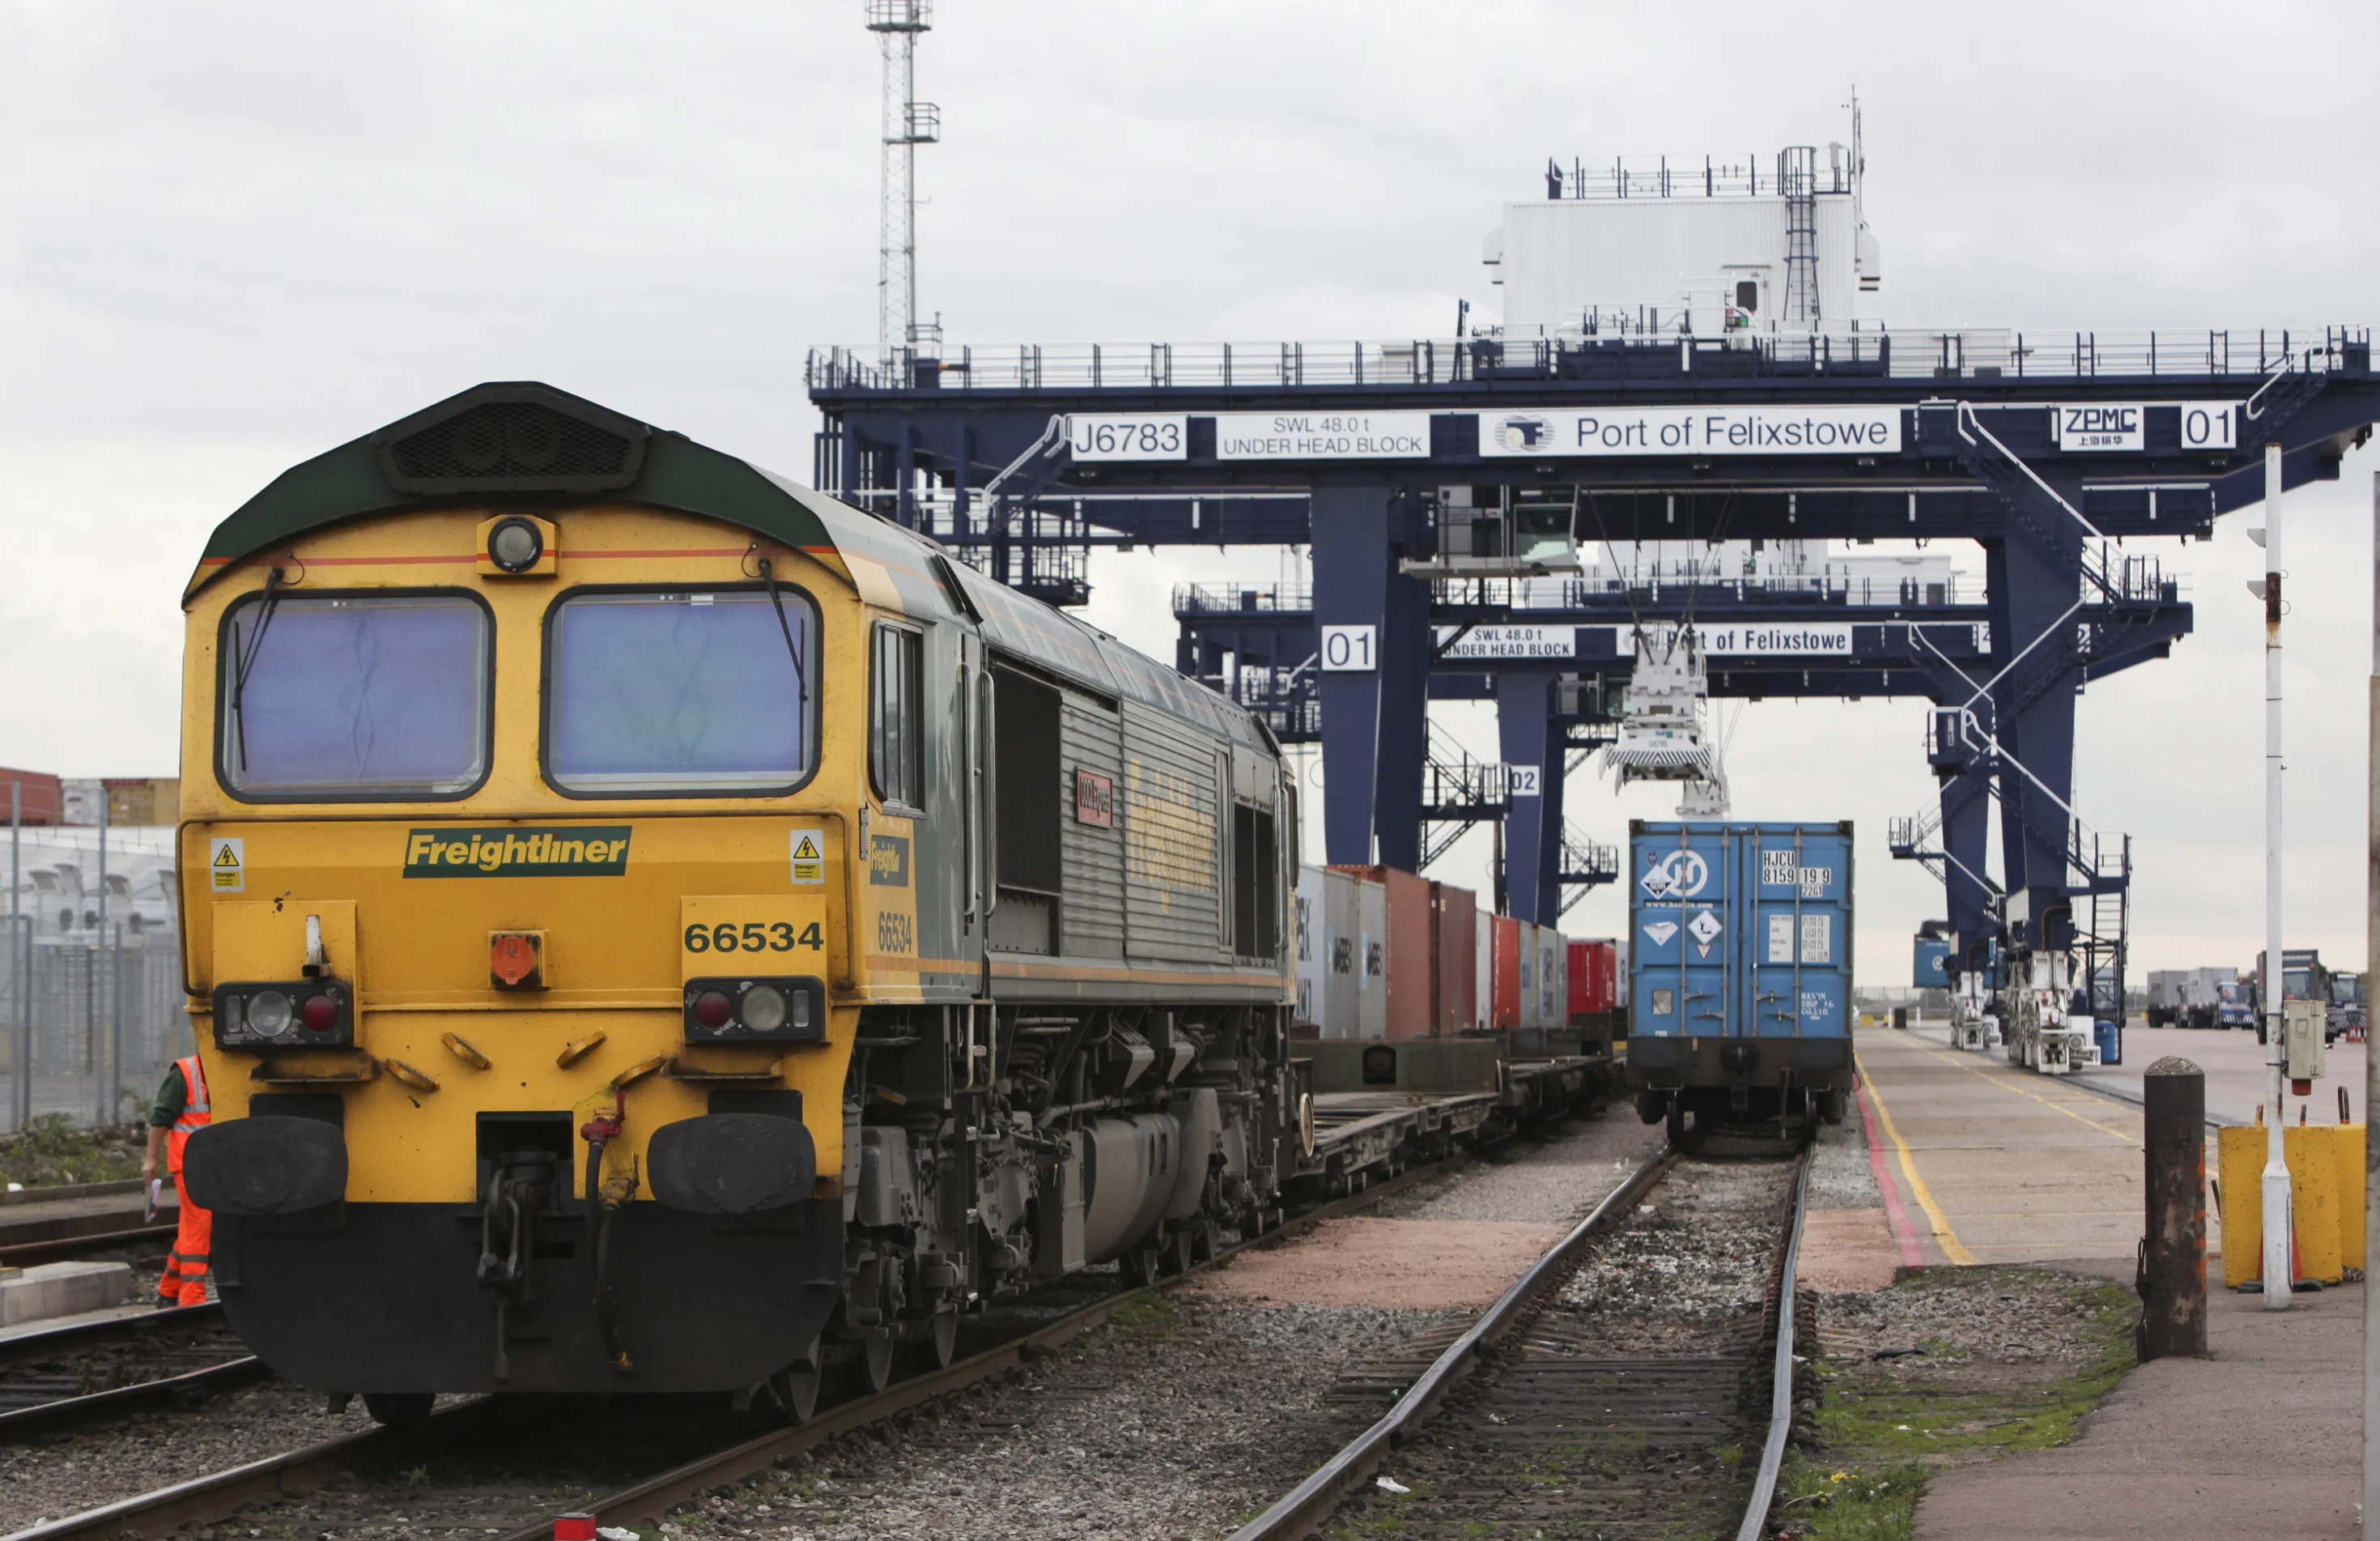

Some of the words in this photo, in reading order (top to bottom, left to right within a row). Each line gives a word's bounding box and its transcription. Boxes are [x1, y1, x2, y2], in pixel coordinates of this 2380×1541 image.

[1273, 417, 1315, 434] SWL
[1320, 417, 1358, 433] 48.0
[1363, 418, 1370, 432] t
[2065, 408, 2137, 433] ZPMC
[2186, 409, 2229, 445] 01
[1075, 423, 1180, 453] J6783
[1578, 417, 1647, 448] Port
[1660, 416, 1693, 447] of
[1706, 416, 1888, 446] Felixstowe
[1224, 438, 1291, 455] UNDER
[1298, 437, 1350, 453] HEAD
[1357, 436, 1422, 453] BLOCK
[1474, 629, 1501, 641] SWL
[1505, 628, 1533, 641] 48.0
[1536, 629, 1542, 641] t
[1716, 630, 1735, 650] of
[1745, 629, 1846, 650] Felixstowe
[1327, 632, 1369, 666] 01
[1490, 644, 1524, 656] HEAD
[1528, 643, 1570, 656] BLOCK
[1512, 771, 1536, 790] 02
[407, 833, 627, 871] Freightliner
[1763, 851, 1795, 866] HJCU
[1763, 868, 1795, 883] 8159
[1802, 886, 1822, 896] 22G1
[1645, 900, 1714, 909] www.hanin.com
[684, 922, 824, 954] 66534
[878, 910, 912, 954] 66534
